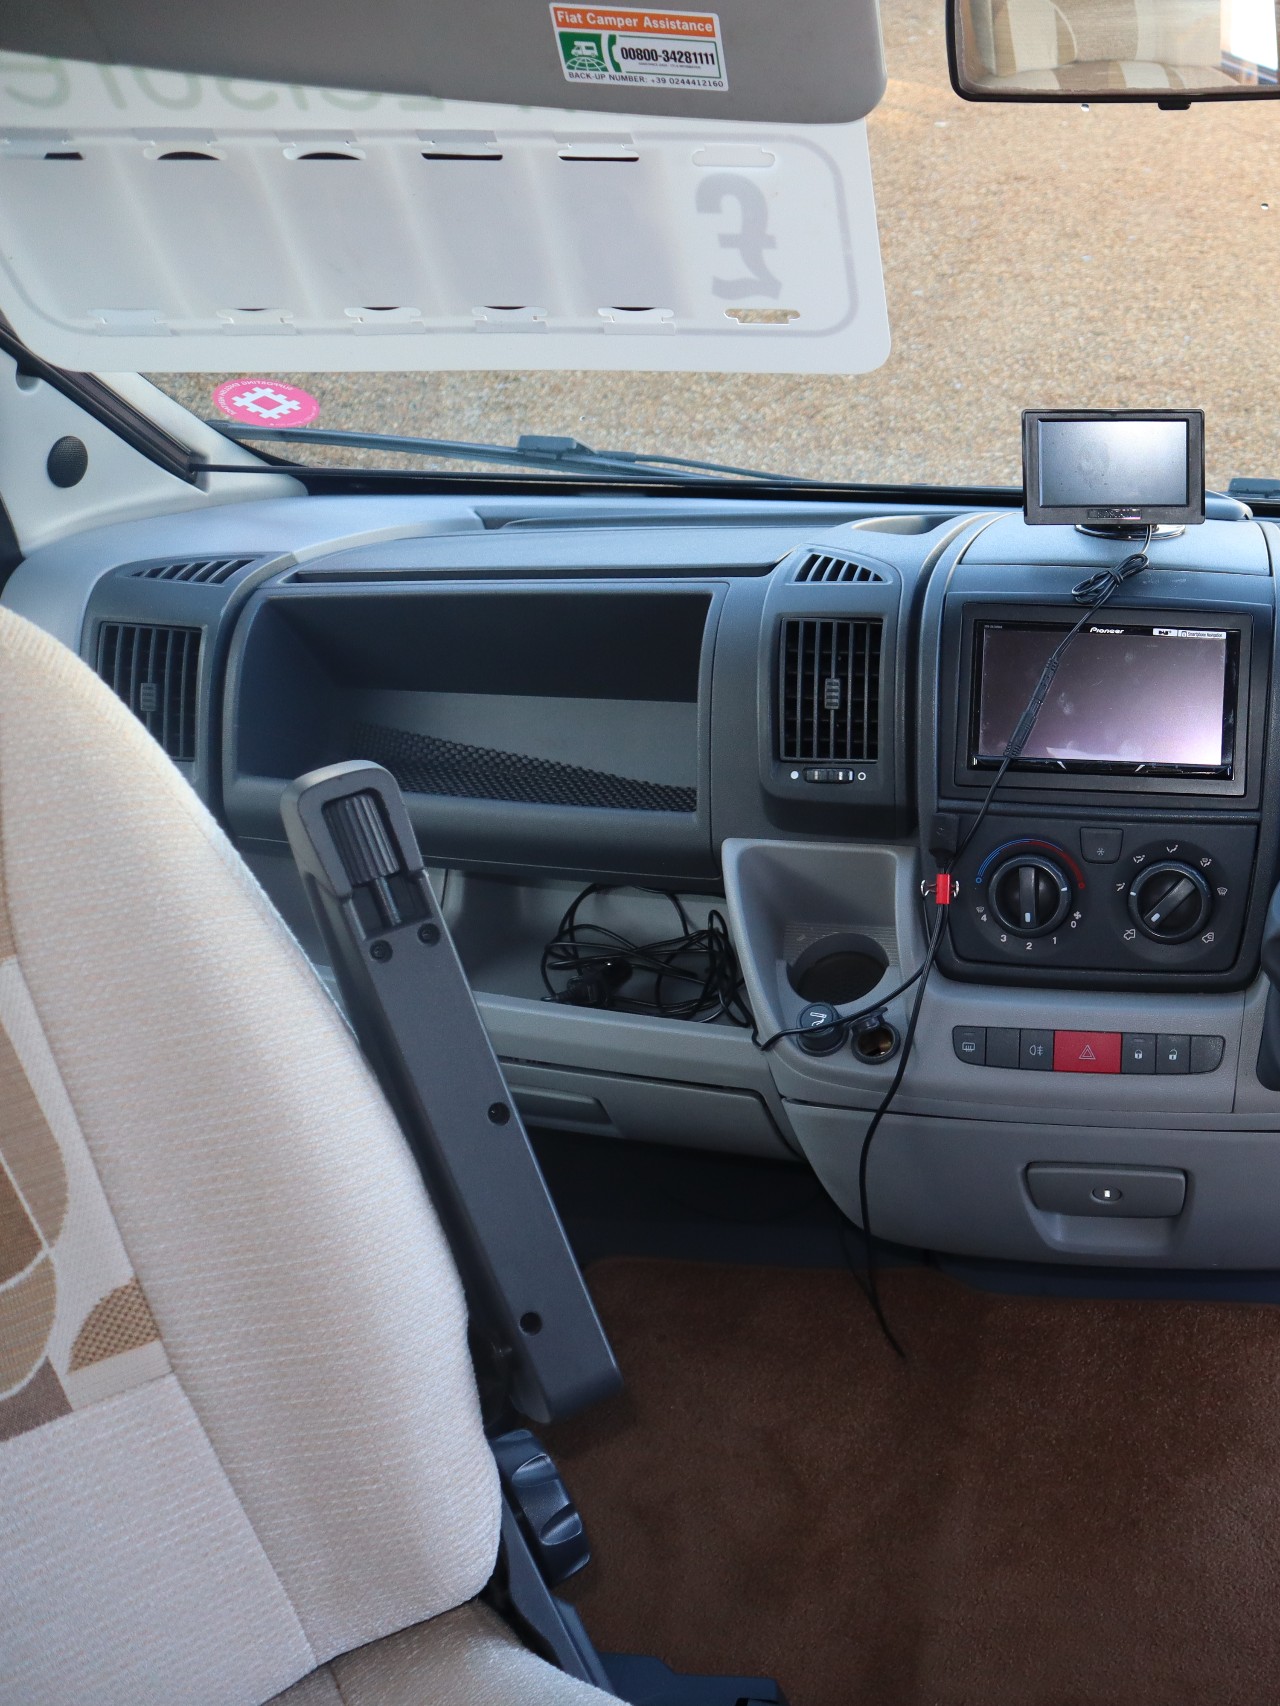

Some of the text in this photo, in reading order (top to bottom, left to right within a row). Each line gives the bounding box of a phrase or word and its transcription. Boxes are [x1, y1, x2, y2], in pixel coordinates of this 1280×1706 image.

[556, 10, 713, 32] Fiat Camper Assistance
[620, 47, 715, 66] 00800-34281111
[568, 71, 724, 88] BACK-UP NUMBER: +39 0244412160
[1089, 626, 1125, 634] Pioneer
[980, 914, 987, 922] 4
[1070, 920, 1077, 929] 0
[1000, 934, 1007, 942] 3
[1052, 936, 1057, 945] 1
[1026, 942, 1033, 950] 2
